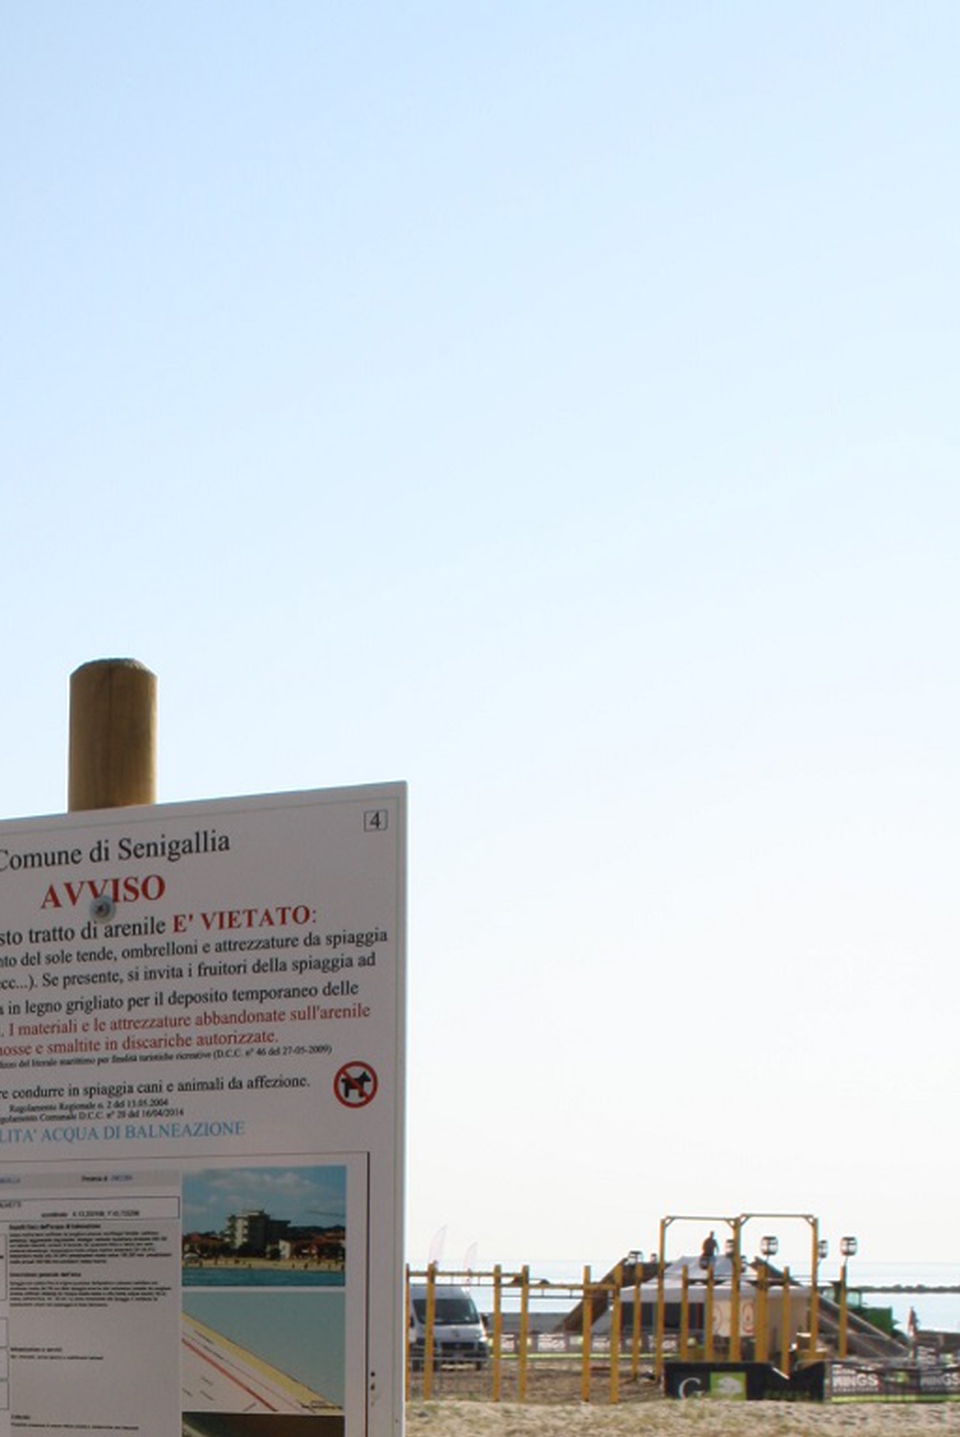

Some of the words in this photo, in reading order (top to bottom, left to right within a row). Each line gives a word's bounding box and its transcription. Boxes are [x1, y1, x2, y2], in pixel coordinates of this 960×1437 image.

[369, 811, 382, 830] 4
[89, 839, 110, 863] di
[118, 830, 230, 862] Senigallia
[39, 874, 167, 911] AVVISO
[28, 926, 75, 944] tratto
[80, 920, 98, 940] di
[103, 915, 166, 938] arenile
[200, 906, 316, 930] VIETATO:
[44, 949, 73, 965] sole
[76, 946, 118, 963] tende,
[121, 941, 198, 960] ombrelloni
[214, 936, 299, 953] attrezzature
[326, 927, 387, 949] spiaggia
[62, 970, 124, 990] presente,
[143, 964, 184, 981] invita
[197, 961, 247, 977] fruitori
[251, 957, 288, 974] della
[291, 956, 354, 975] spiaggia
[25, 999, 63, 1017] legno
[65, 994, 124, 1016] grigliato
[167, 987, 228, 1009] deposito
[232, 986, 319, 1004] temporaneo
[322, 979, 359, 997] delle
[18, 1018, 78, 1036] materiali
[109, 1015, 191, 1031] attrezzature
[194, 1008, 286, 1026] abbandonate
[289, 1002, 370, 1021] sull'arenile
[46, 1038, 101, 1054] smaltite
[121, 1032, 192, 1051] discariche
[196, 1030, 278, 1047] autorizzate.
[11, 1084, 65, 1100] condurre
[82, 1081, 134, 1099] spiaggia
[136, 1079, 163, 1094] cani
[177, 1076, 224, 1092] animali
[246, 1074, 310, 1089] affezione.
[41, 1126, 99, 1144] ACQUA
[103, 1124, 120, 1140] DI
[124, 1120, 244, 1139] BALNEAZIONE
